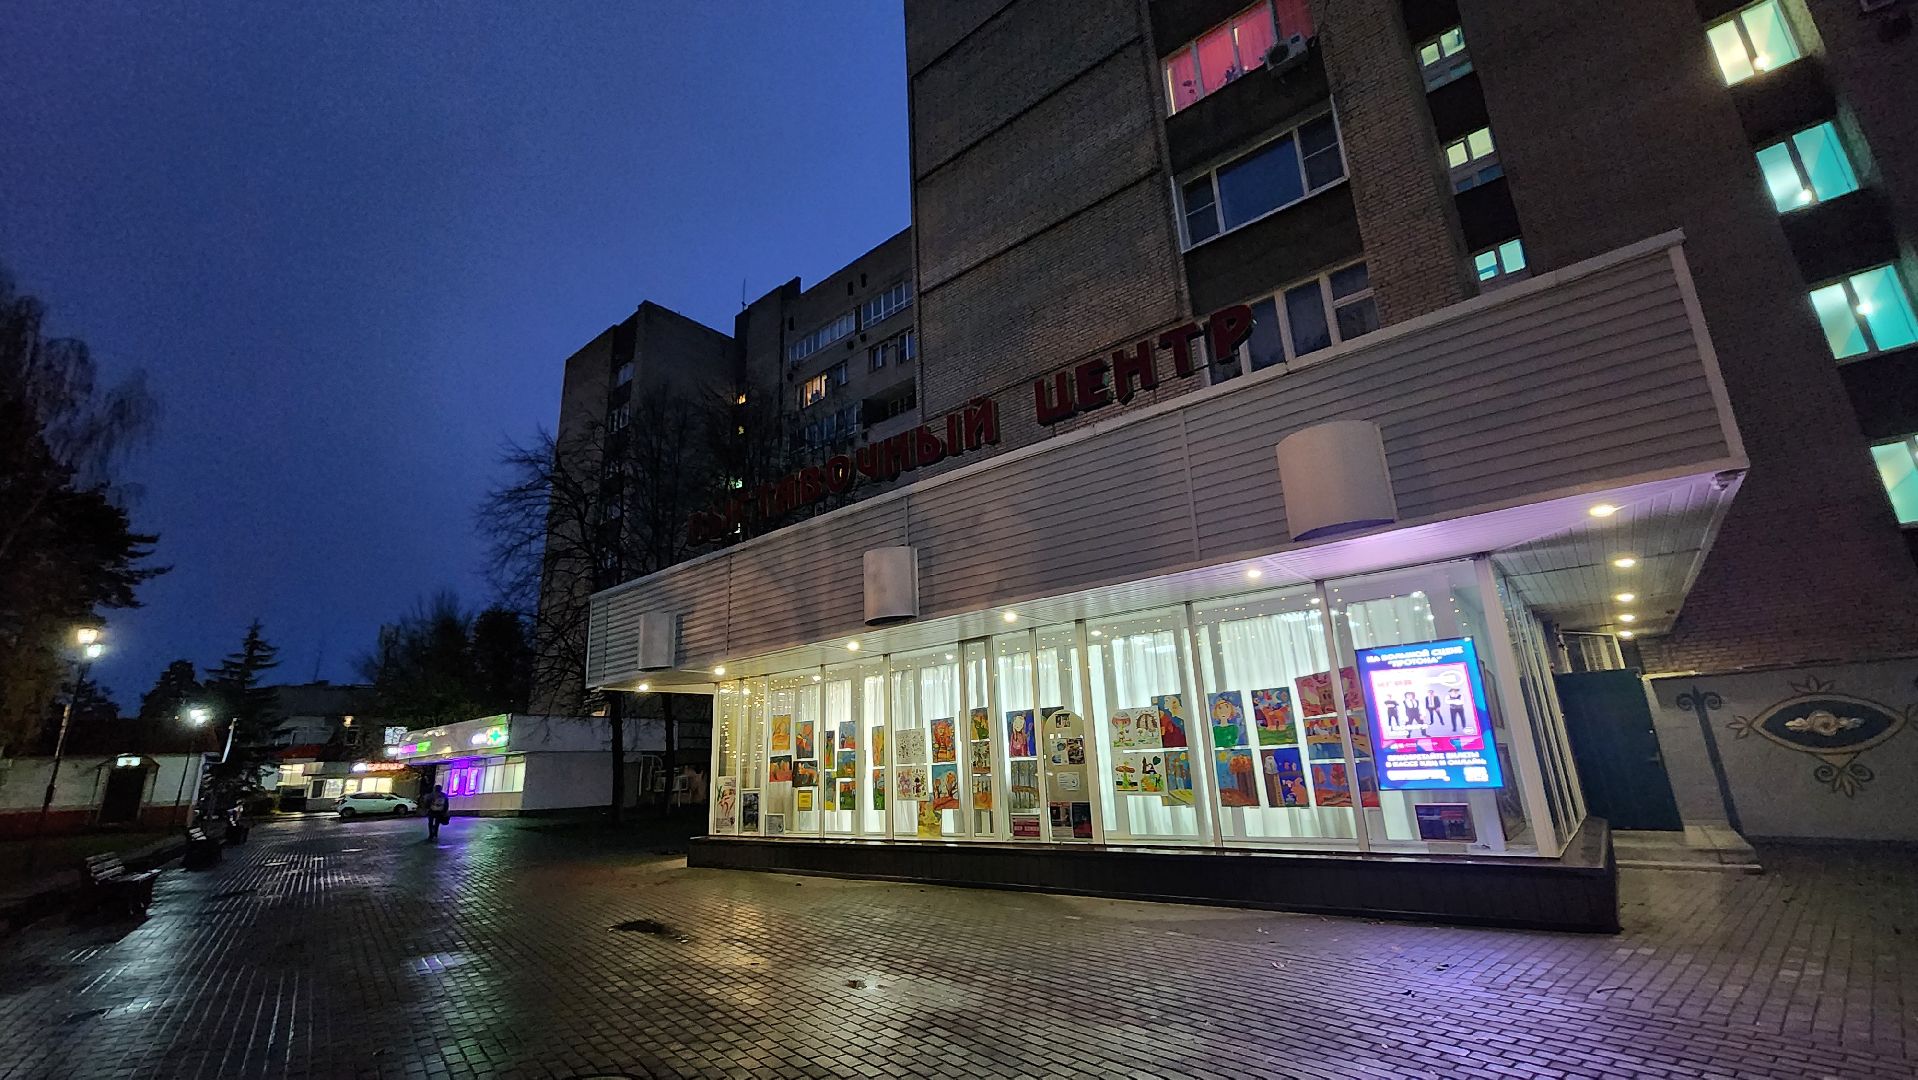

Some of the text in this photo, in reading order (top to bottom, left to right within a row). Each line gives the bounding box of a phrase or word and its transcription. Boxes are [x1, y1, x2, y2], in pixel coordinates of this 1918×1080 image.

[1034, 304, 1254, 427] ЦЕНТР
[1366, 646, 1463, 663] НА БОЛЬШОЙ СЦЕНЕ
